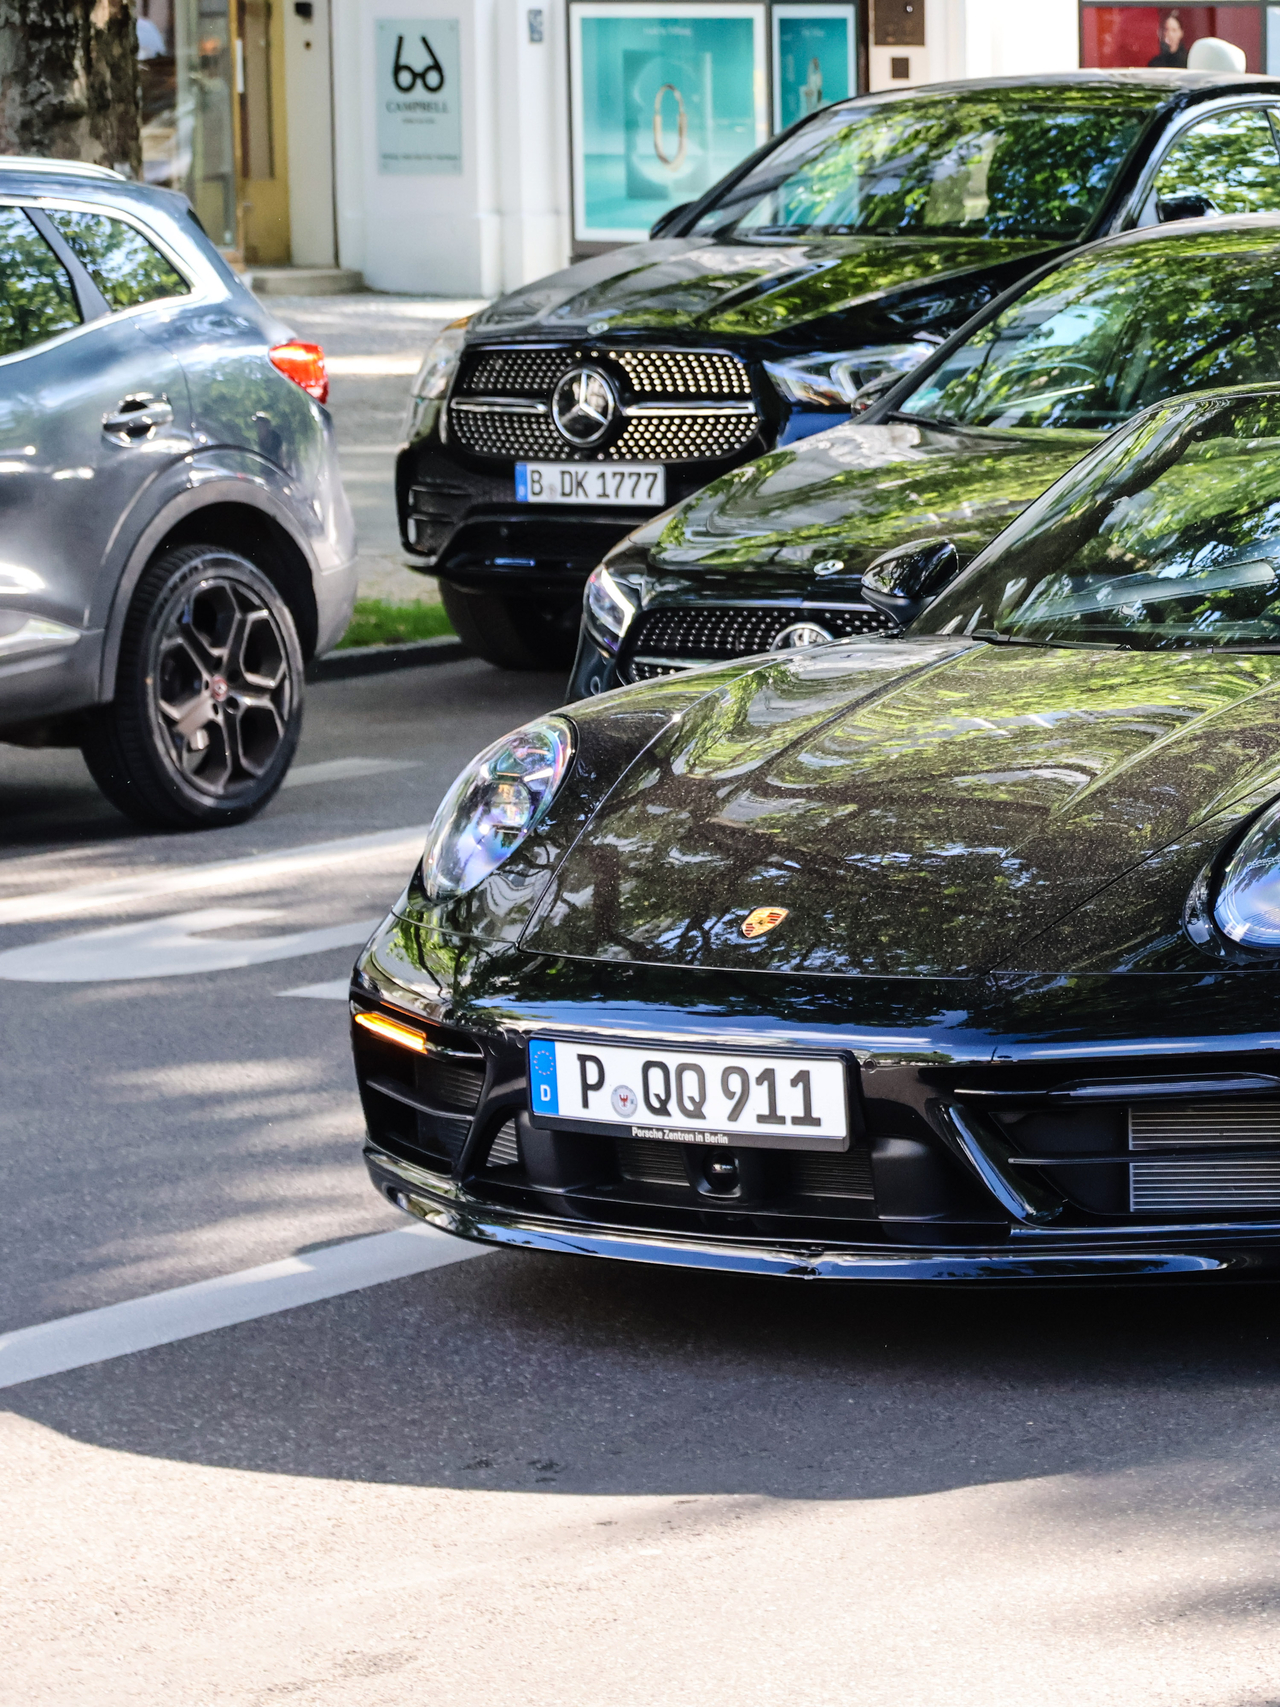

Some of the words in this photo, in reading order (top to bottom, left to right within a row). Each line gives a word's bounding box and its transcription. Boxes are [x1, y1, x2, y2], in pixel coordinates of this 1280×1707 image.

[530, 470, 543, 496] B
[560, 470, 589, 499] DK
[596, 472, 658, 499] 1777
[540, 1084, 551, 1101] D
[577, 1053, 605, 1109] P
[641, 1060, 707, 1120] QQ
[720, 1065, 822, 1127] 911
[631, 1126, 663, 1139] Porsche
[663, 1129, 694, 1142] Zentren
[695, 1132, 704, 1142] in
[704, 1133, 729, 1144] Berlin
